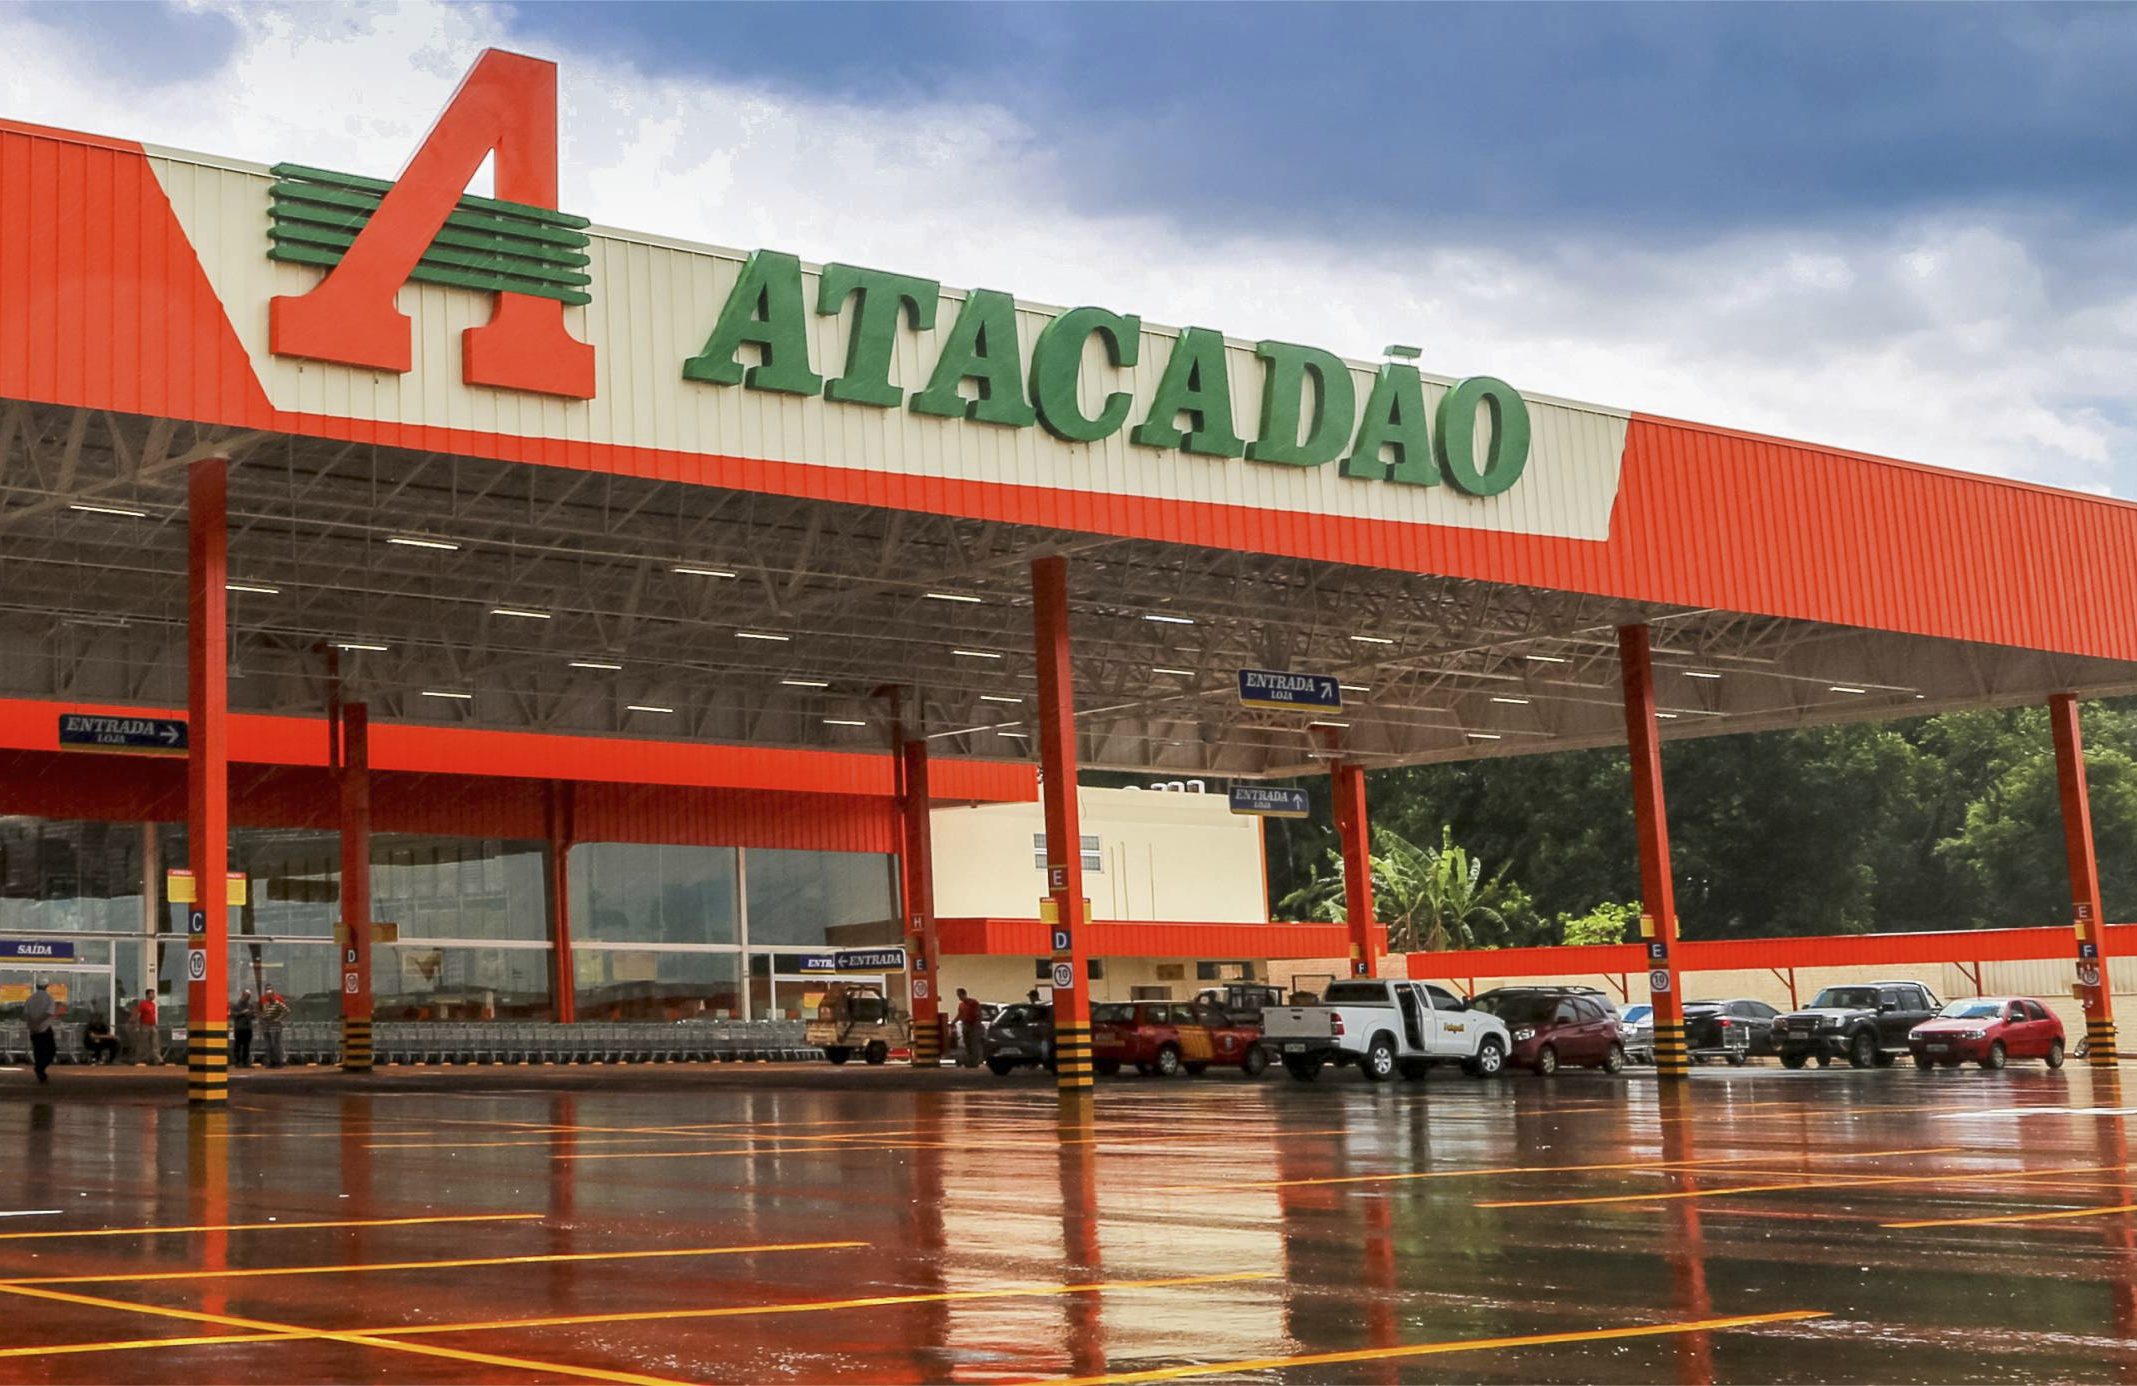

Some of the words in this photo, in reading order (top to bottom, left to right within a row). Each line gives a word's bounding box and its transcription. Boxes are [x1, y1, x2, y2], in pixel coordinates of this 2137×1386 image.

[270, 47, 596, 401] A
[683, 248, 1531, 498] ATACADÃO
[1246, 672, 1315, 692] ENTRADA
[1271, 690, 1293, 701] LOJA
[66, 716, 155, 735] ENTRADA
[97, 733, 126, 744] LOJA
[1235, 788, 1288, 803] ENTRADA
[1053, 870, 1062, 886] E
[2078, 906, 2088, 918] E
[192, 912, 202, 932] C
[913, 917, 922, 929] H
[1055, 932, 1067, 949] D
[17, 943, 52, 955] SAÍDA
[348, 949, 356, 962] D
[1652, 944, 1662, 957] E
[2083, 945, 2092, 957] F
[808, 959, 835, 968] ENTR
[849, 954, 902, 967] ENTRADA
[916, 960, 923, 970] E
[1058, 970, 1068, 979] 10
[1358, 963, 1365, 973] F
